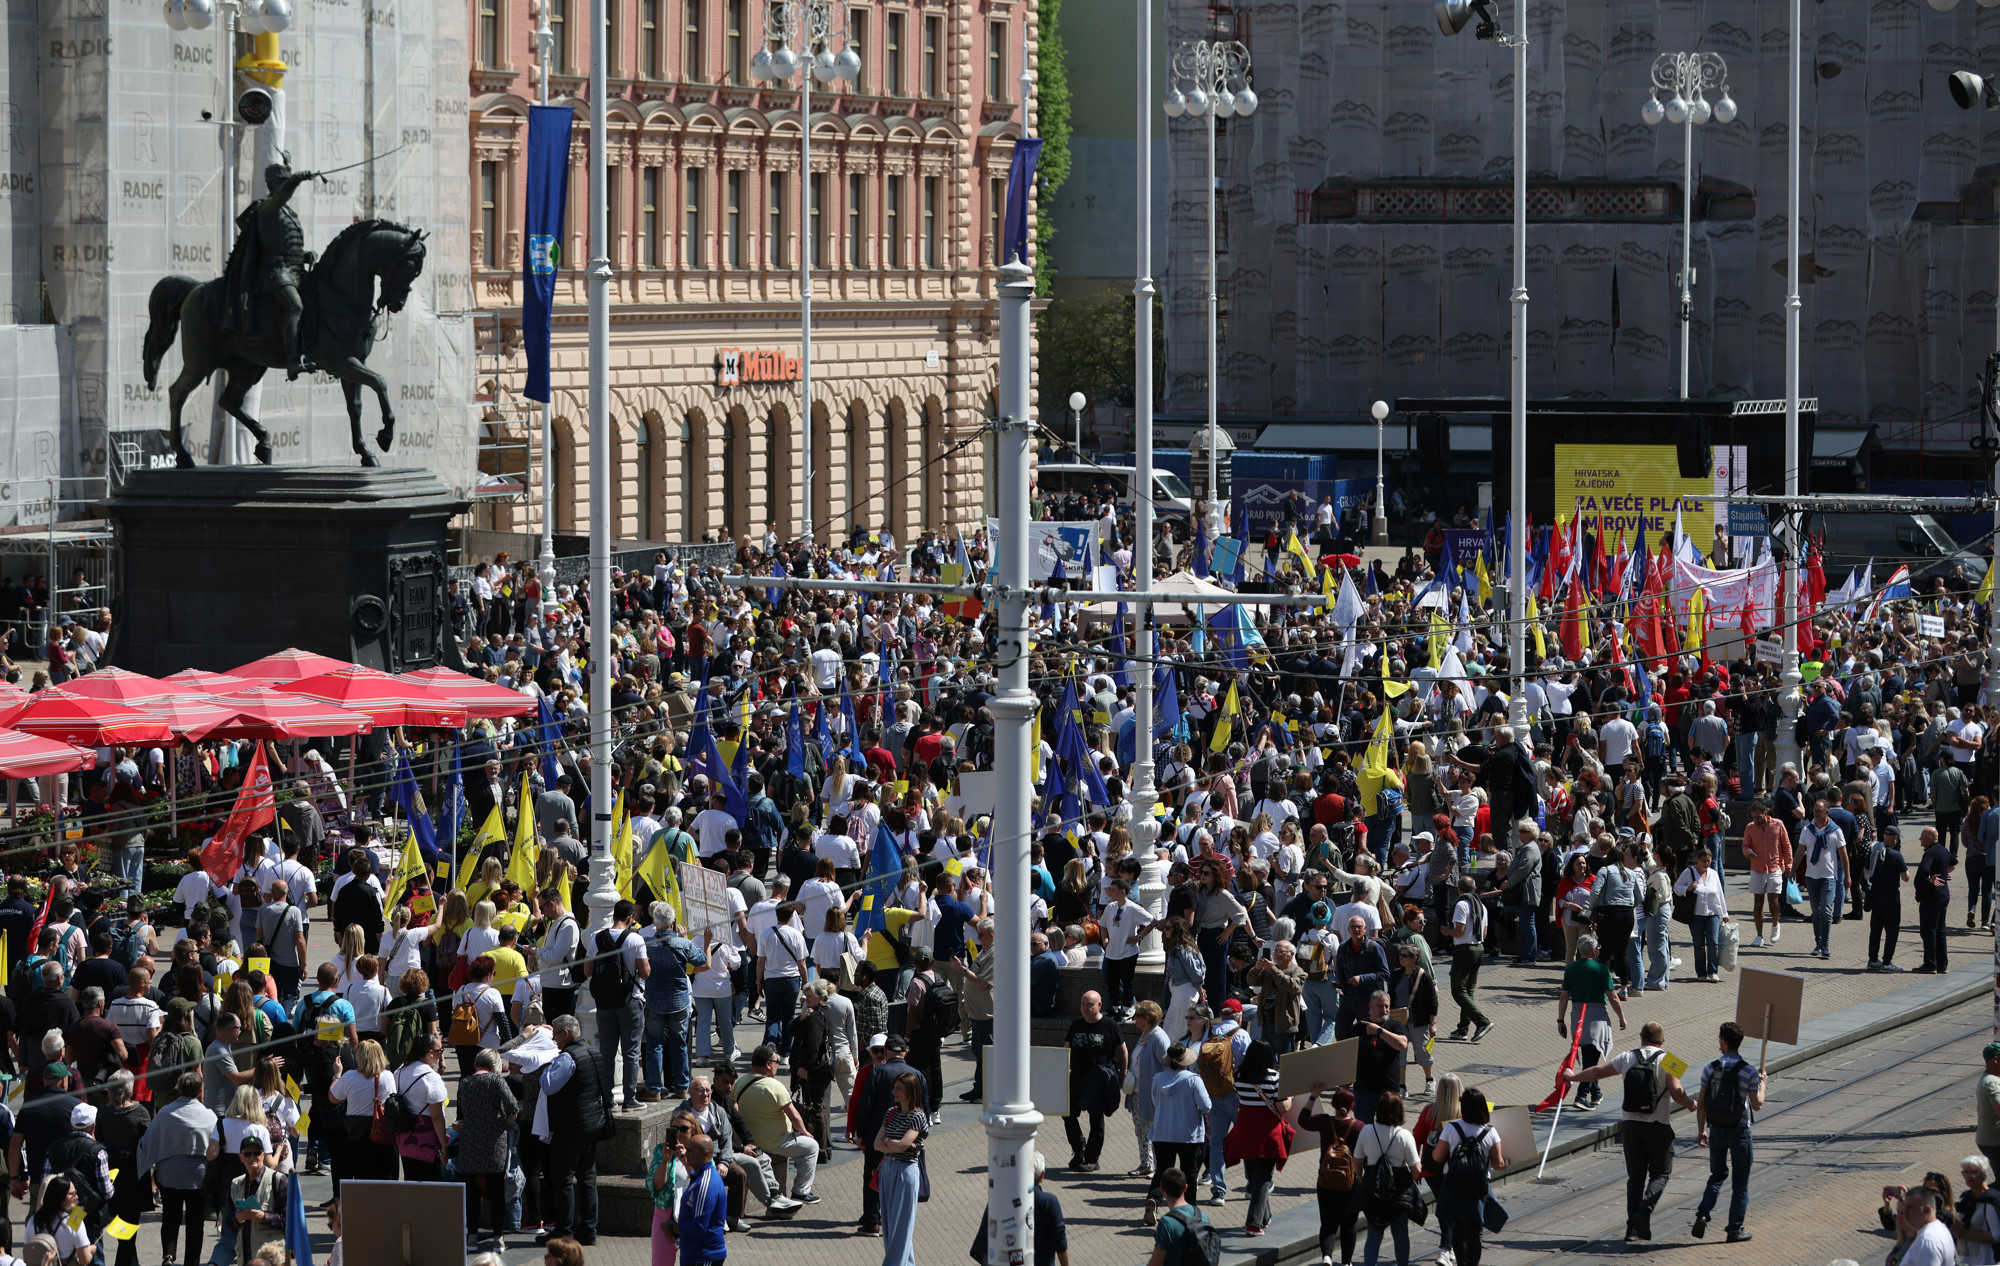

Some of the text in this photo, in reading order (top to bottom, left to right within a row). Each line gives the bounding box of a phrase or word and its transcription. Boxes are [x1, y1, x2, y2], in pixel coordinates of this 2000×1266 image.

[173, 43, 213, 65] RADIĆ
[0, 172, 34, 194] ADIĆ
[123, 178, 163, 200] RADIĆ
[53, 241, 114, 262] RADIĆ
[172, 241, 212, 263] RADIĆ
[743, 350, 803, 382] Müller
[401, 380, 435, 400] RADIĆ
[400, 429, 434, 449] RADIĆ
[1236, 431, 1253, 440] SOL
[1575, 469, 1620, 479] HRVATSKA
[1575, 480, 1615, 489] ZAJEDNO
[1576, 496, 1599, 511] ZA
[1604, 492, 1644, 512] VEĆE
[1732, 521, 1765, 533] tramvaja
